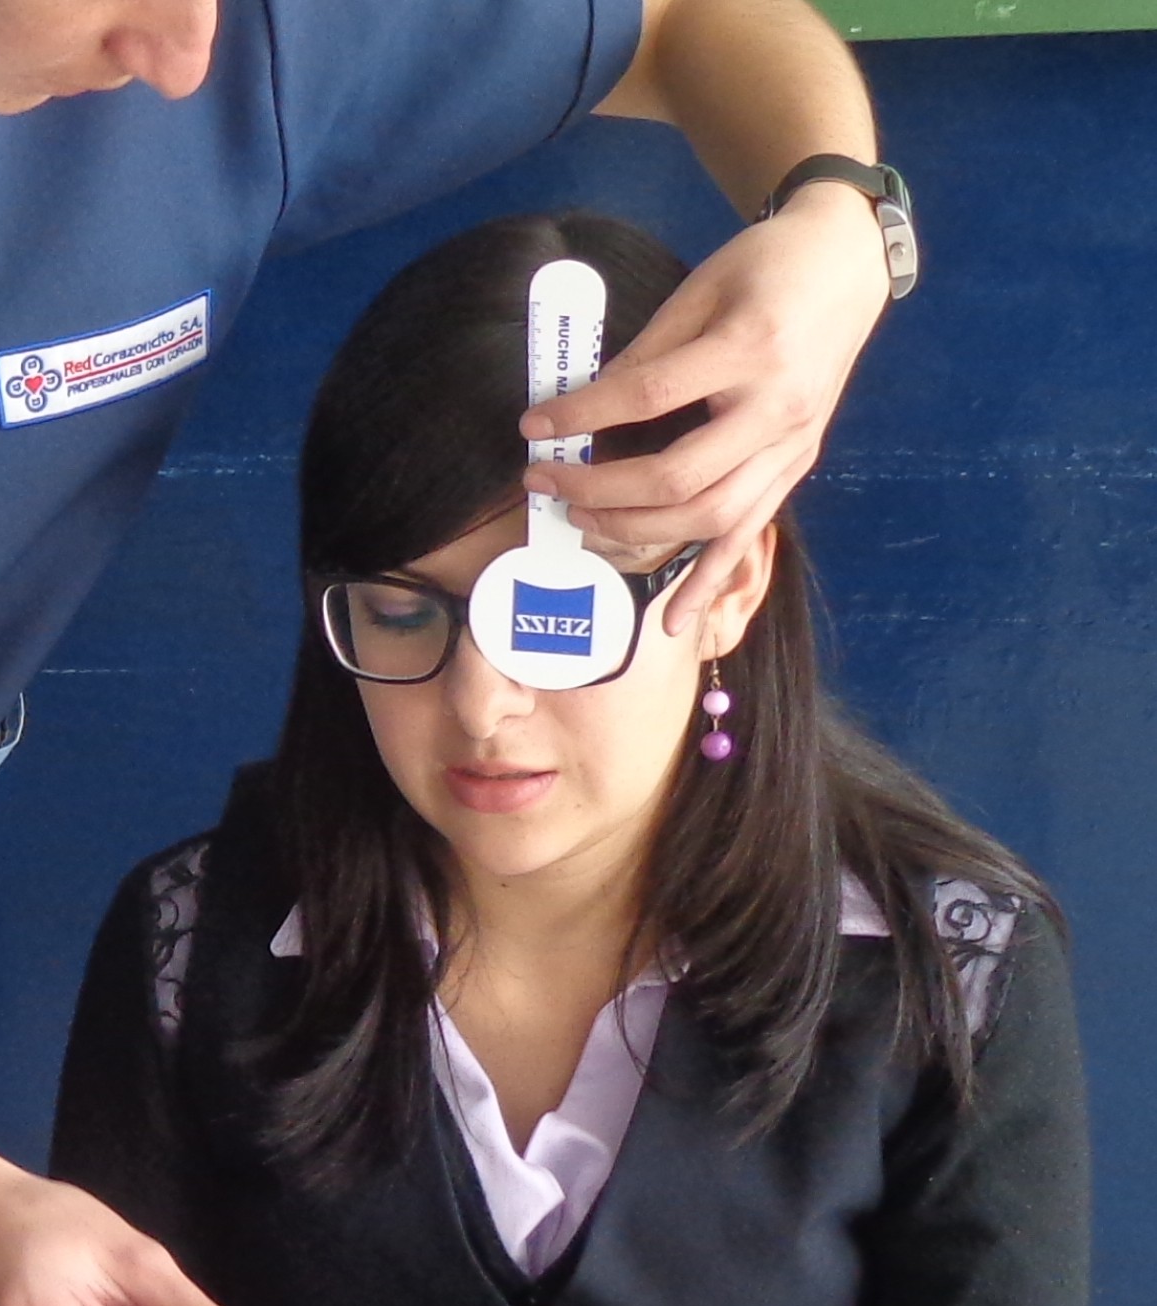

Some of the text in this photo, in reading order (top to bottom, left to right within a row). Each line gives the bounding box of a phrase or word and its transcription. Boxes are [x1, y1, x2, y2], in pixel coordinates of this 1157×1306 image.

[557, 315, 570, 371] MUCHO
[67, 364, 143, 397] PROFESIONALES
[146, 357, 165, 371] CON
[514, 614, 591, 637] ZEISS
